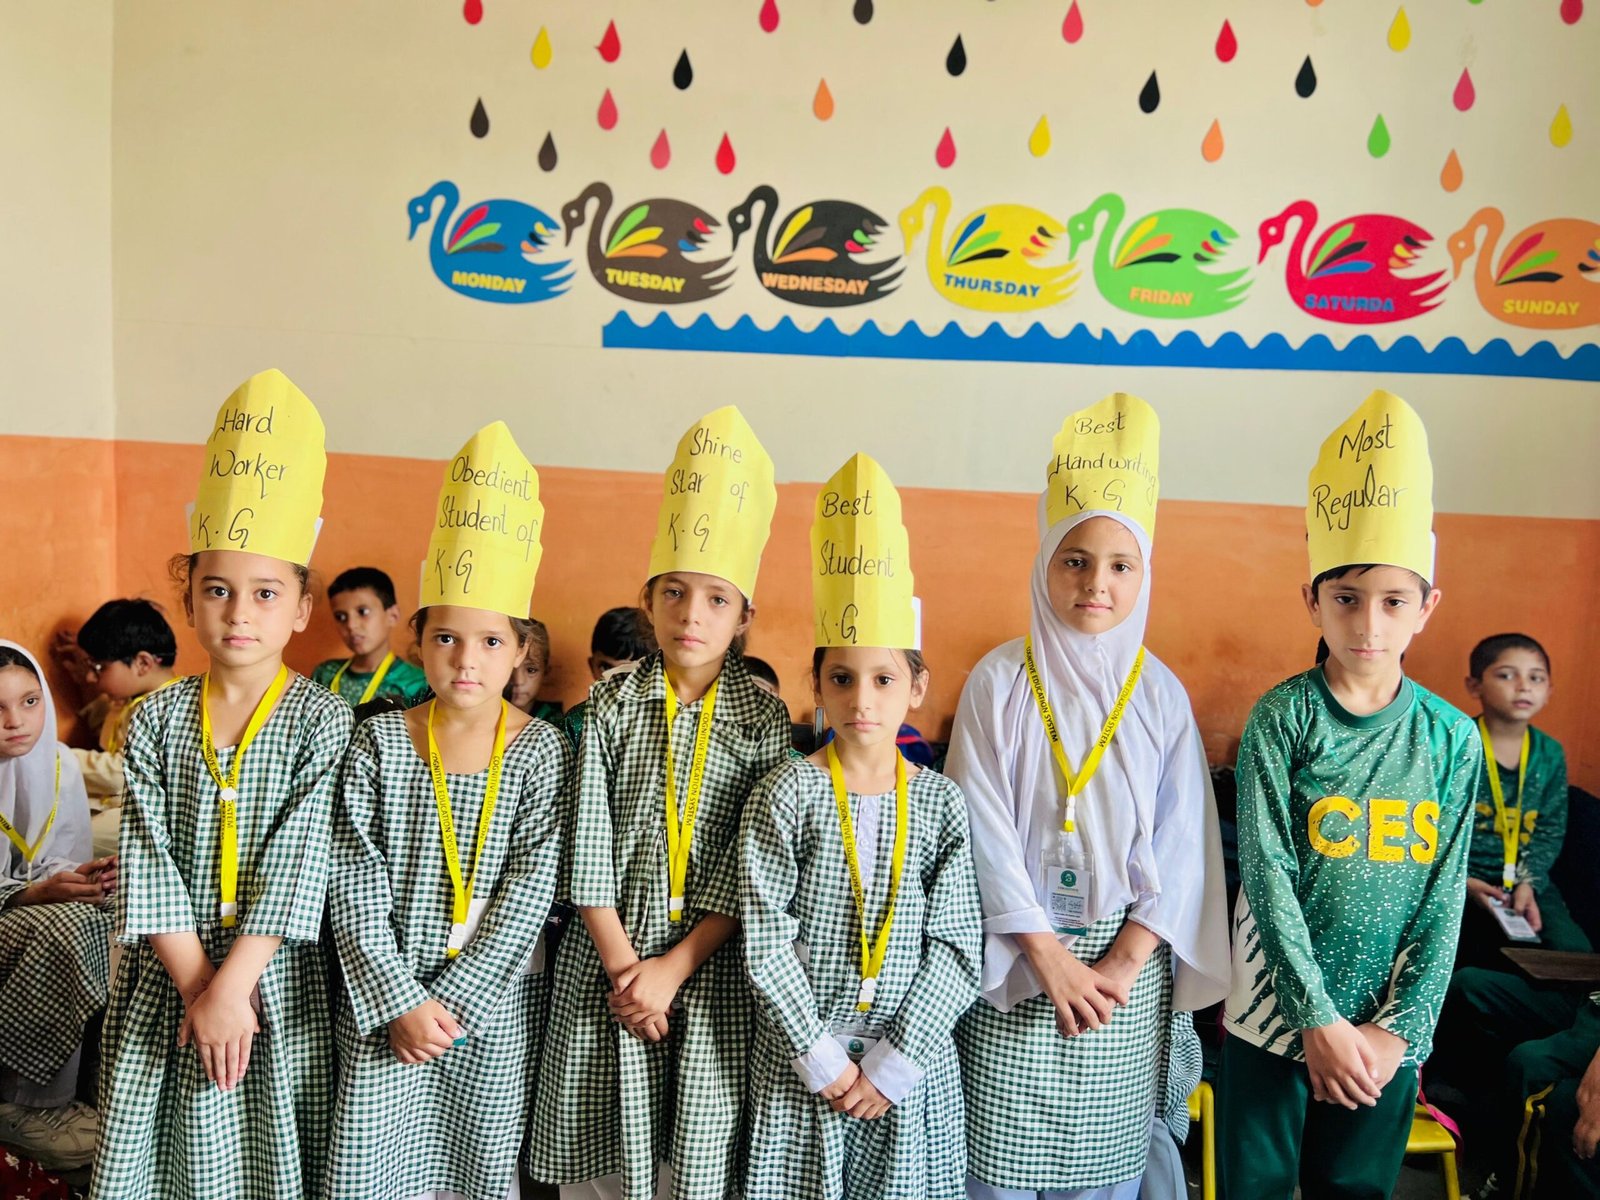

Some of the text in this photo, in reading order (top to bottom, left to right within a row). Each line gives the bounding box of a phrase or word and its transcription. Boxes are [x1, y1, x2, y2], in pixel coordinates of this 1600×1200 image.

[451, 270, 527, 294] MONDAY
[605, 268, 686, 294] TUESDAY
[761, 272, 870, 296] WEDNESDAY
[943, 273, 1041, 298] THURSDAY
[1129, 286, 1194, 307] FRIDAY
[1304, 293, 1395, 313] SATURDA
[1502, 299, 1580, 316] SUNDAY
[213, 406, 274, 442] Hard
[1074, 411, 1126, 435] Best
[1338, 413, 1396, 463] Most
[689, 427, 743, 464] Shine
[210, 449, 288, 500] Worker
[451, 455, 533, 501] Obedient
[670, 469, 750, 513] Star of
[821, 489, 873, 518] Best
[1312, 463, 1408, 532] Regular
[439, 495, 539, 562] Student of
[819, 539, 895, 578] Student
[1031, 674, 1049, 713] EDUCATION
[1045, 714, 1059, 743] SYSTEM
[1099, 721, 1115, 748] SYSTEM
[489, 755, 500, 793] COGNITIVE
[686, 713, 710, 827] COGNITIVE EDUCATION SYSTEM
[431, 751, 457, 864] COGNITIVE EDUCATION SYSTEM
[480, 794, 496, 839] EDUCATION
[839, 801, 851, 840] COGNITIVE
[846, 842, 859, 887] EDUCATION
[1307, 795, 1441, 865] CES
